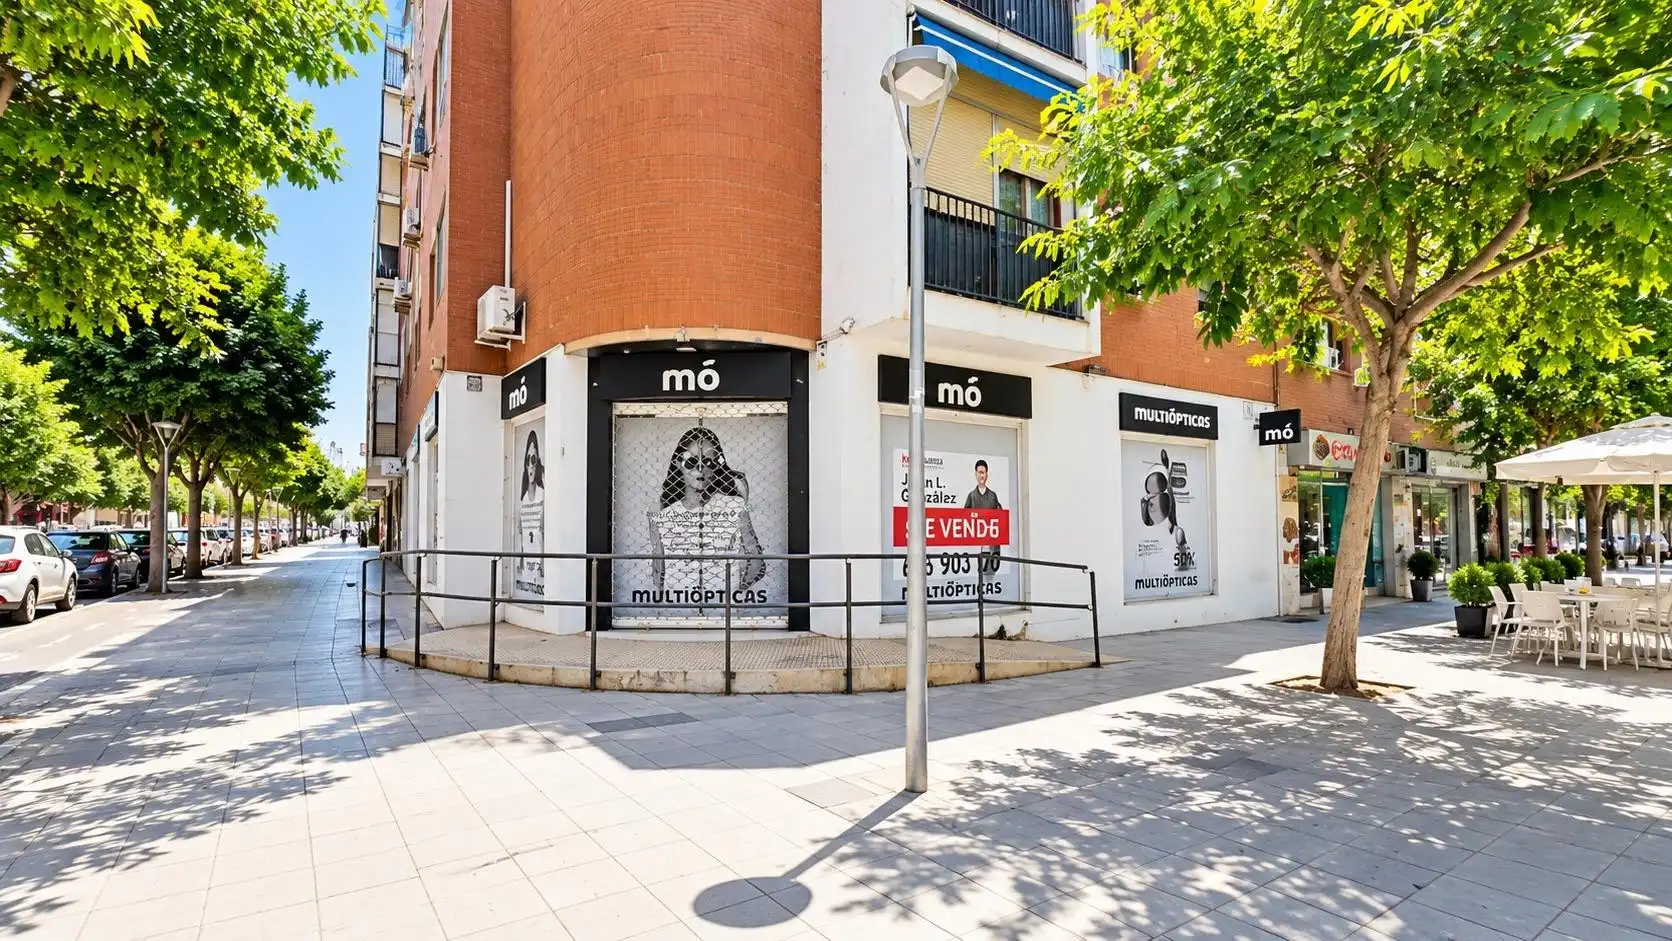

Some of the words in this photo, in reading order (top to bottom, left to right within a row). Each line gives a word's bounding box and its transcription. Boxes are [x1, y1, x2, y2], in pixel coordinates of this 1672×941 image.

[662, 360, 720, 392] mó
[509, 376, 528, 410] mó
[937, 376, 982, 408] mó
[1265, 422, 1294, 441] mó
[901, 473, 933, 488] Jn
[936, 477, 946, 489] L.
[901, 488, 957, 504] Gzález
[905, 517, 935, 539] E
[940, 552, 971, 575] 903
